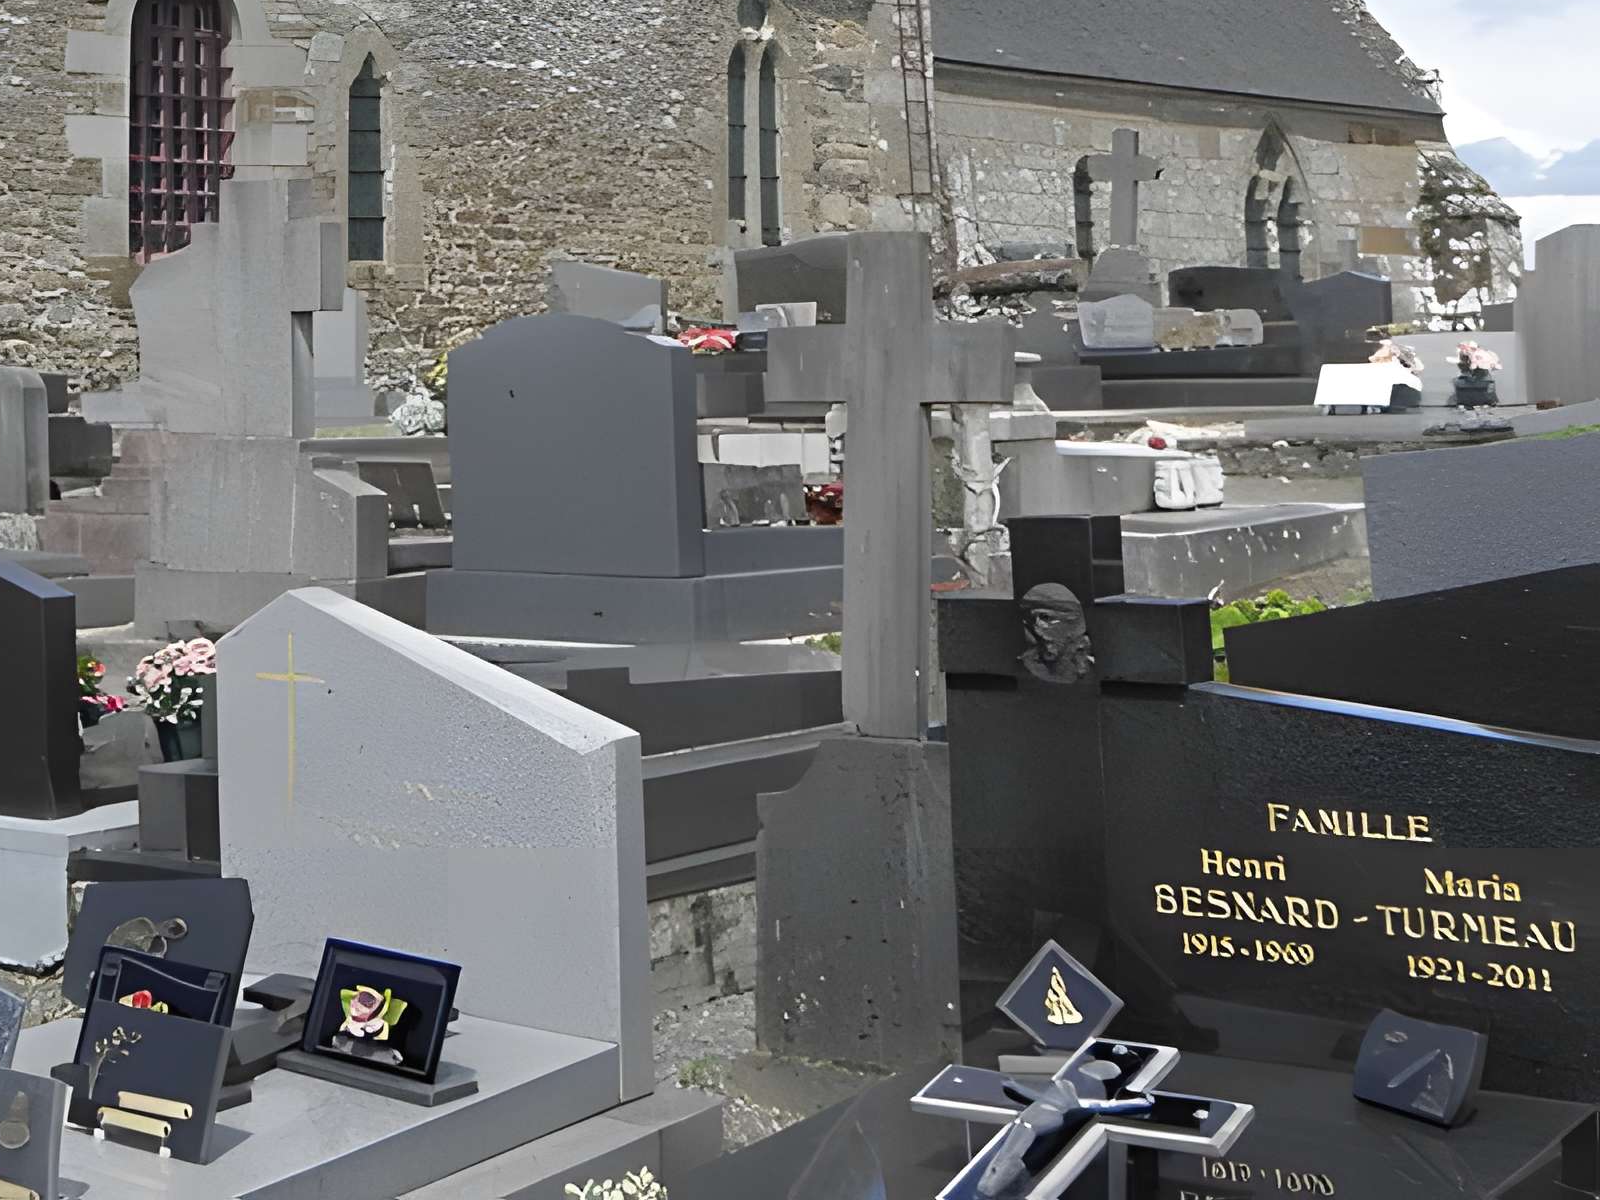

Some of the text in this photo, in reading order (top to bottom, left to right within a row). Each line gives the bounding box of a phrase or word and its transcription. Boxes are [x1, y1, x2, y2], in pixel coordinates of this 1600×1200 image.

[1267, 802, 1433, 843] FAMILLE
[1200, 848, 1287, 882] Henri
[1423, 866, 1523, 903] Maria
[1153, 884, 1340, 930] BESNARD
[1374, 904, 1577, 953] TURMEAU
